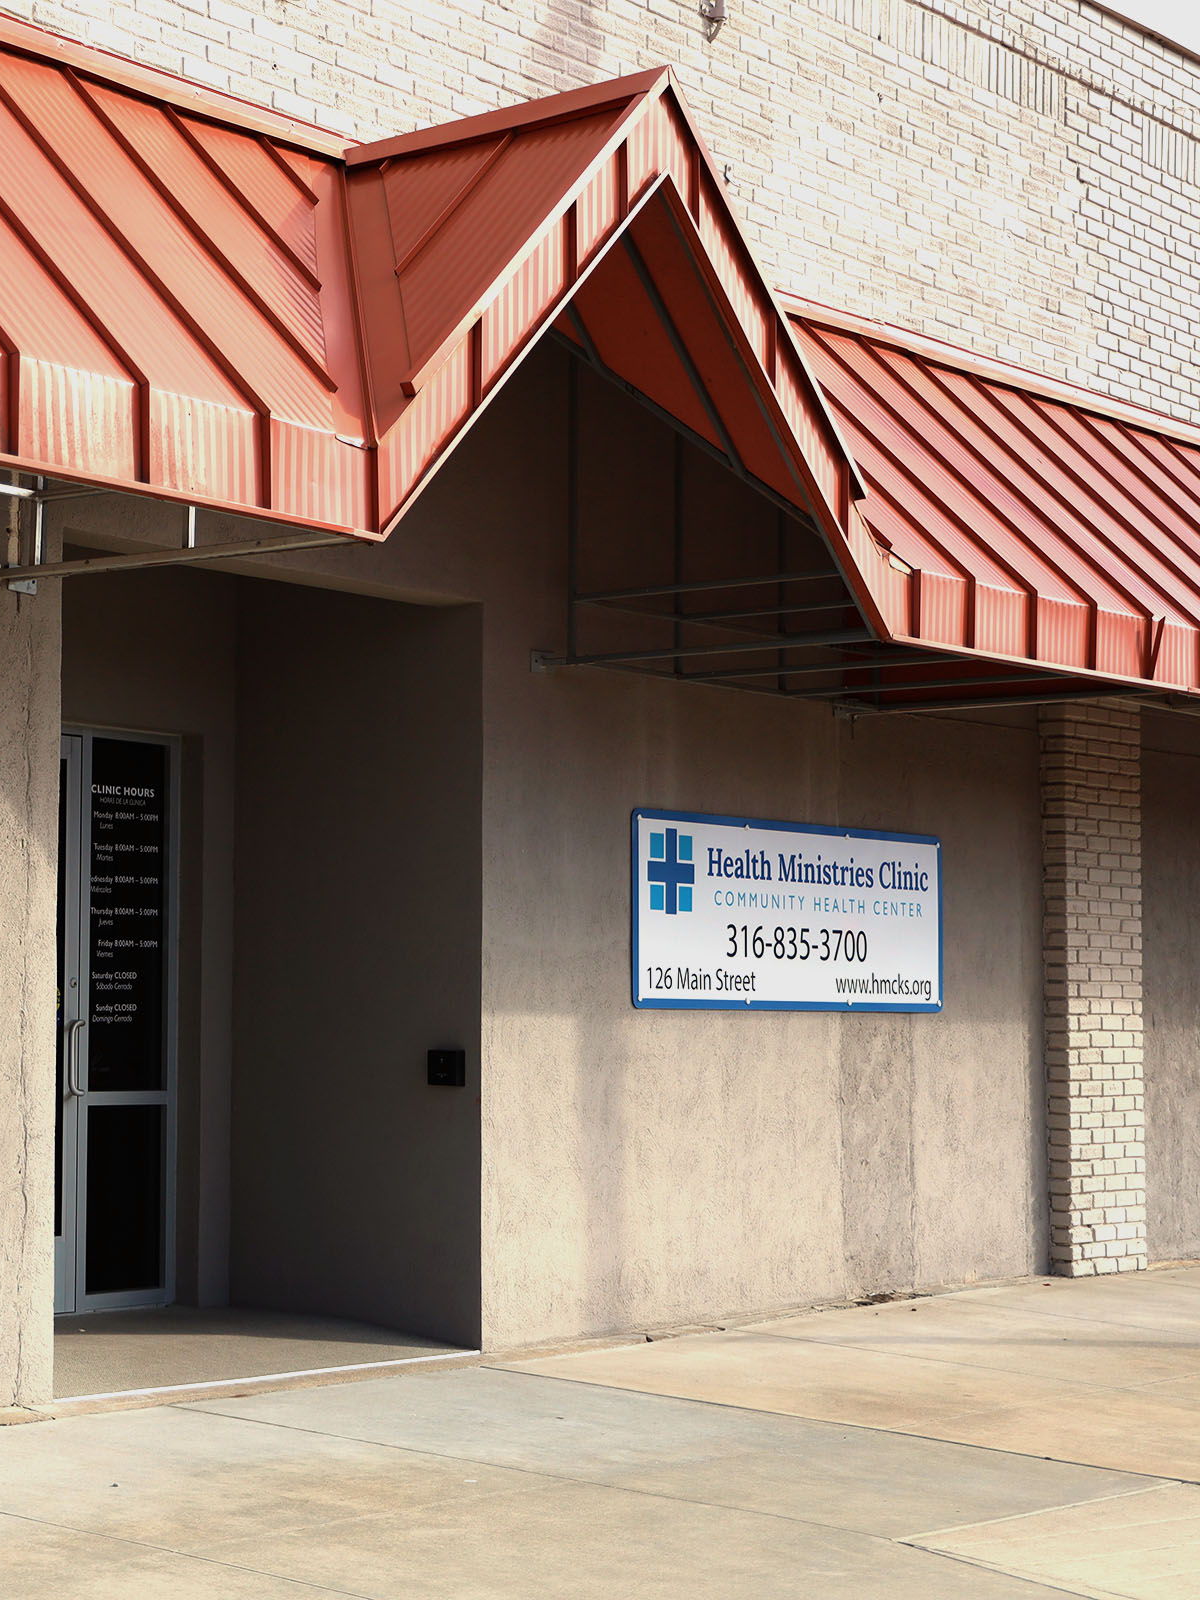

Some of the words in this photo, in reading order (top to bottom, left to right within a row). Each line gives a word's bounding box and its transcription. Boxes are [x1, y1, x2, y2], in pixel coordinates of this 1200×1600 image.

[91, 784, 121, 795] CLINIC
[124, 786, 155, 798] HOURS
[93, 811, 113, 820] Monday
[93, 843, 113, 852] Tuesday
[707, 847, 772, 881] Health
[778, 853, 874, 888] Ministries
[879, 861, 929, 892] Clinic
[90, 875, 113, 884] ednesday
[714, 890, 805, 910] COMMUNITY
[813, 897, 866, 914] HEALTH
[873, 900, 922, 918] CENTER
[90, 907, 113, 917] Thursday
[98, 939, 113, 949] Friday
[726, 924, 868, 963] 316-835-3700
[92, 972, 113, 981] Saturday
[114, 972, 137, 980] CLOSED
[646, 967, 673, 990] 126
[676, 967, 712, 991] Main
[715, 969, 756, 992] Street
[835, 972, 932, 1001] www.hmcks.org
[96, 1004, 113, 1012] Sunday
